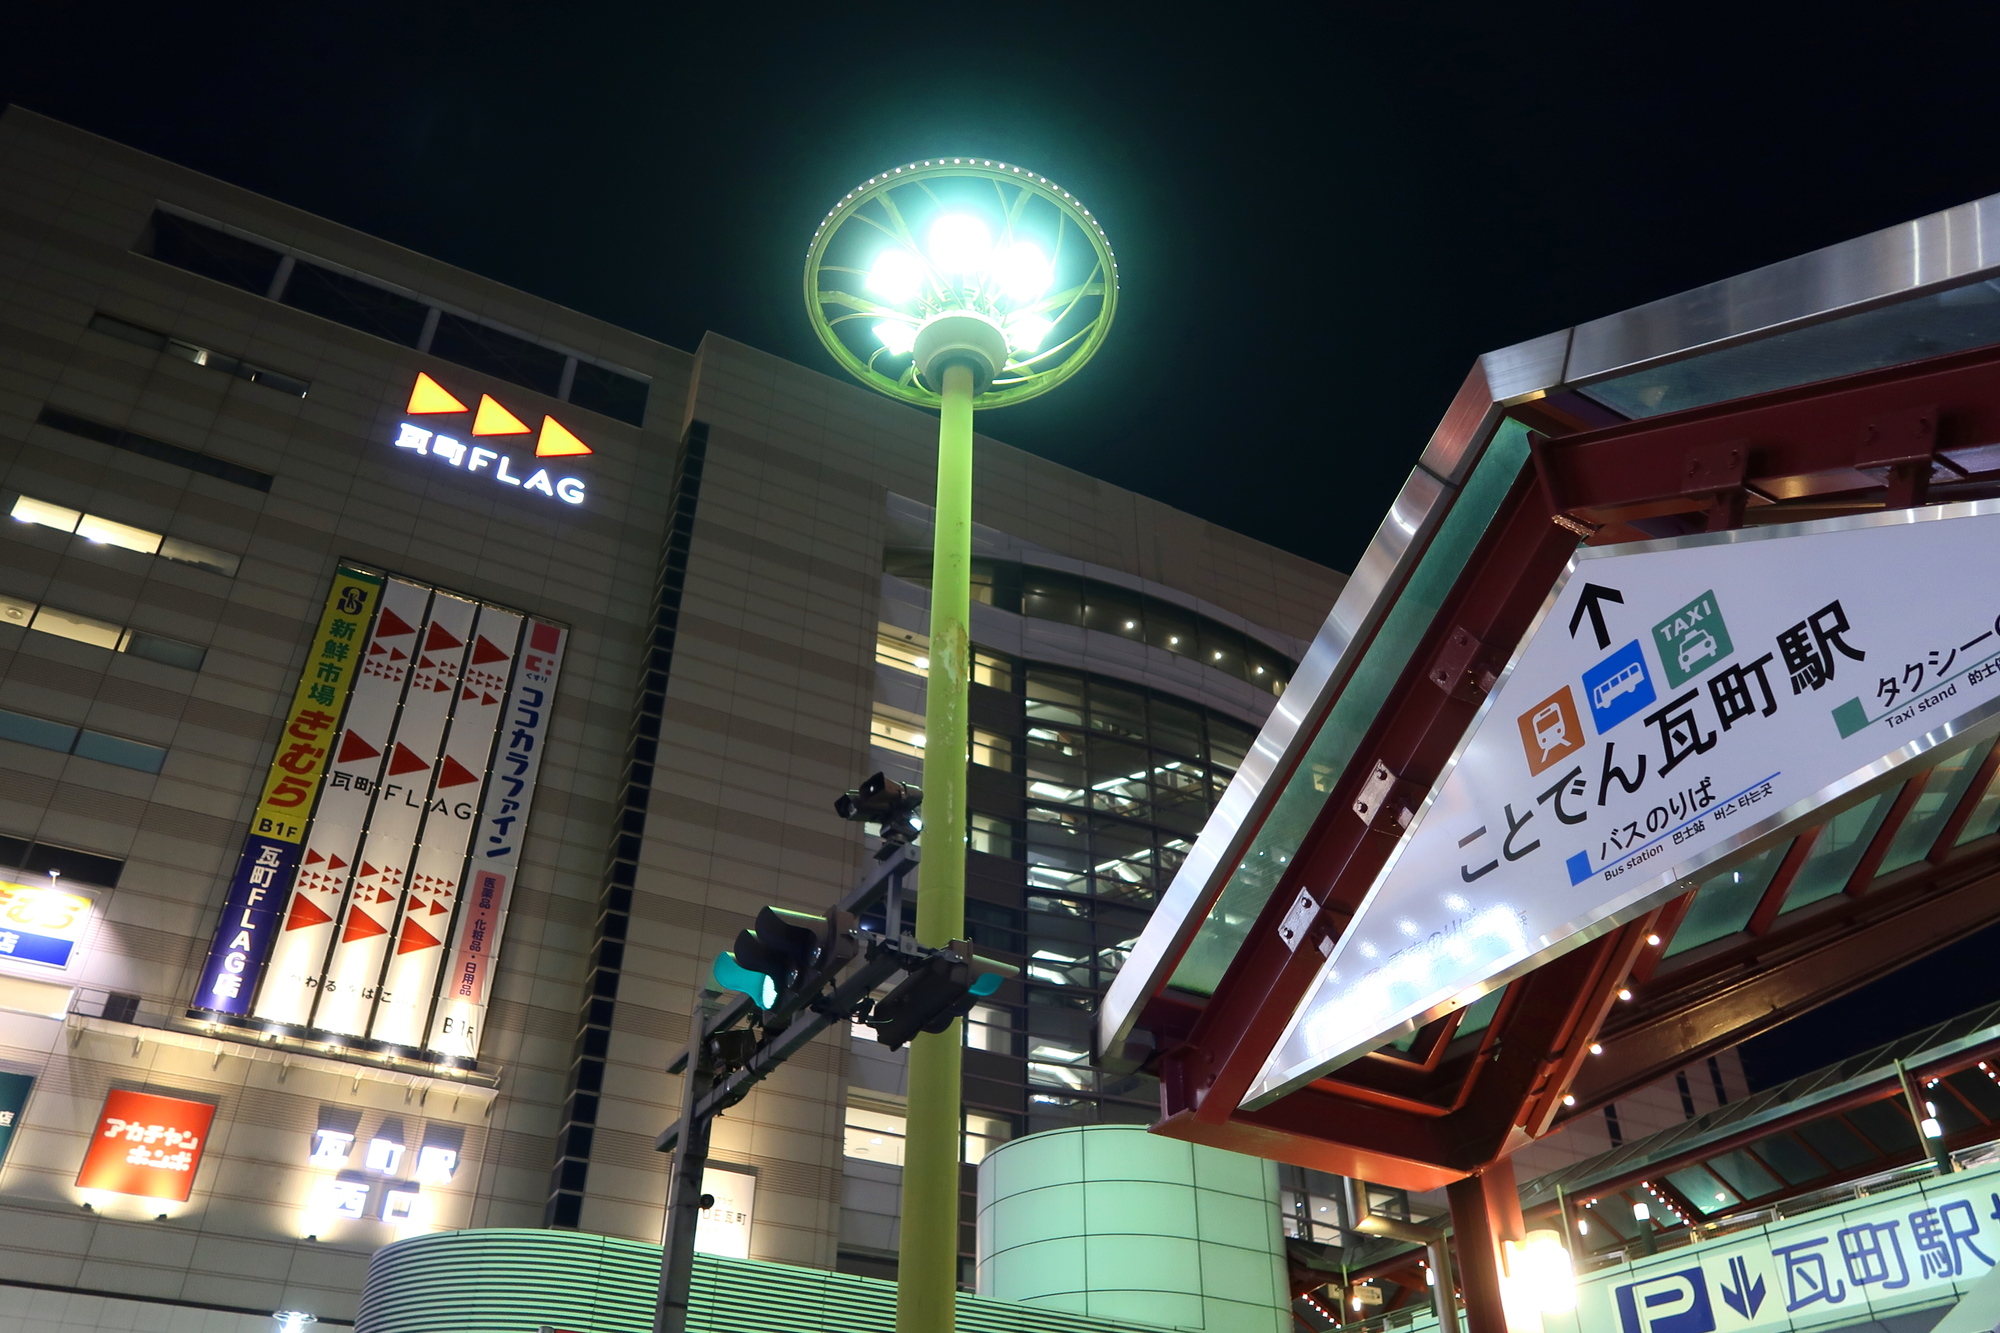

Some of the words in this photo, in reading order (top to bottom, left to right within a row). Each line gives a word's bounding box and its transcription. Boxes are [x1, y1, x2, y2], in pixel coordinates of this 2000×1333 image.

[394, 422, 586, 505] 瓦町FLAG
[307, 618, 357, 707] 新鮮市場
[1660, 599, 1712, 641] TAXI
[1876, 613, 2000, 708] タクシー
[1885, 705, 1916, 728] Taxi
[1918, 683, 1958, 712] stand
[1967, 656, 2000, 687] 的士
[266, 709, 336, 808] きむら
[486, 686, 544, 858] ココカラファイン
[1458, 599, 1867, 883] ことでん瓦町駅
[258, 818, 299, 839] B1F
[330, 770, 472, 820] 瓦町FLAG
[1600, 776, 1717, 861] バスのりば
[1604, 866, 1625, 881] Bus
[1626, 844, 1664, 870] station
[1672, 820, 1706, 846] 巴士站
[1713, 803, 1738, 822] 버스
[1738, 782, 1774, 808] 타는곳
[192, 844, 284, 999] 瓦町FLAG店
[442, 1017, 474, 1041] B1F
[1772, 1192, 2000, 1312] 瓦町駅
